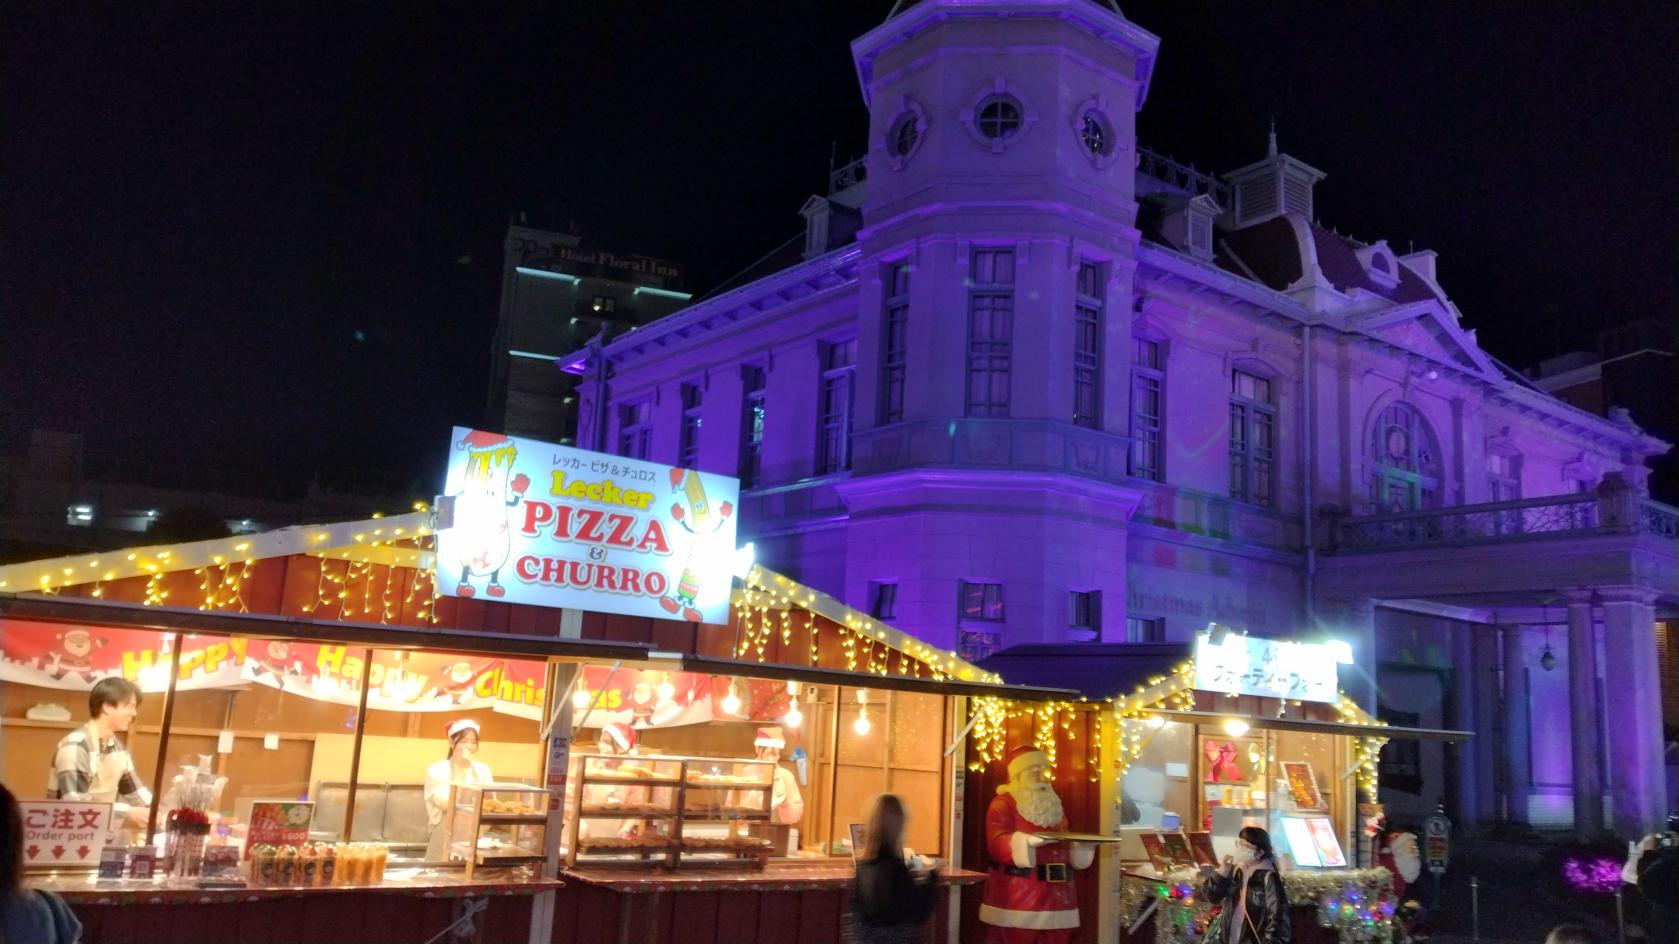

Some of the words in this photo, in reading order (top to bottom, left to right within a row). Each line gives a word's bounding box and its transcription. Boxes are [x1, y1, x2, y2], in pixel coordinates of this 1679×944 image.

[600, 252, 646, 272] Floral
[650, 261, 678, 277] Inn
[552, 453, 587, 470] レッカー
[549, 470, 656, 510] Lecker
[521, 500, 670, 553] PIZZA
[589, 546, 604, 560] &
[515, 555, 667, 595] CHURRO
[26, 808, 101, 830] ご注文
[26, 830, 64, 841] Order
[67, 831, 95, 843] port
